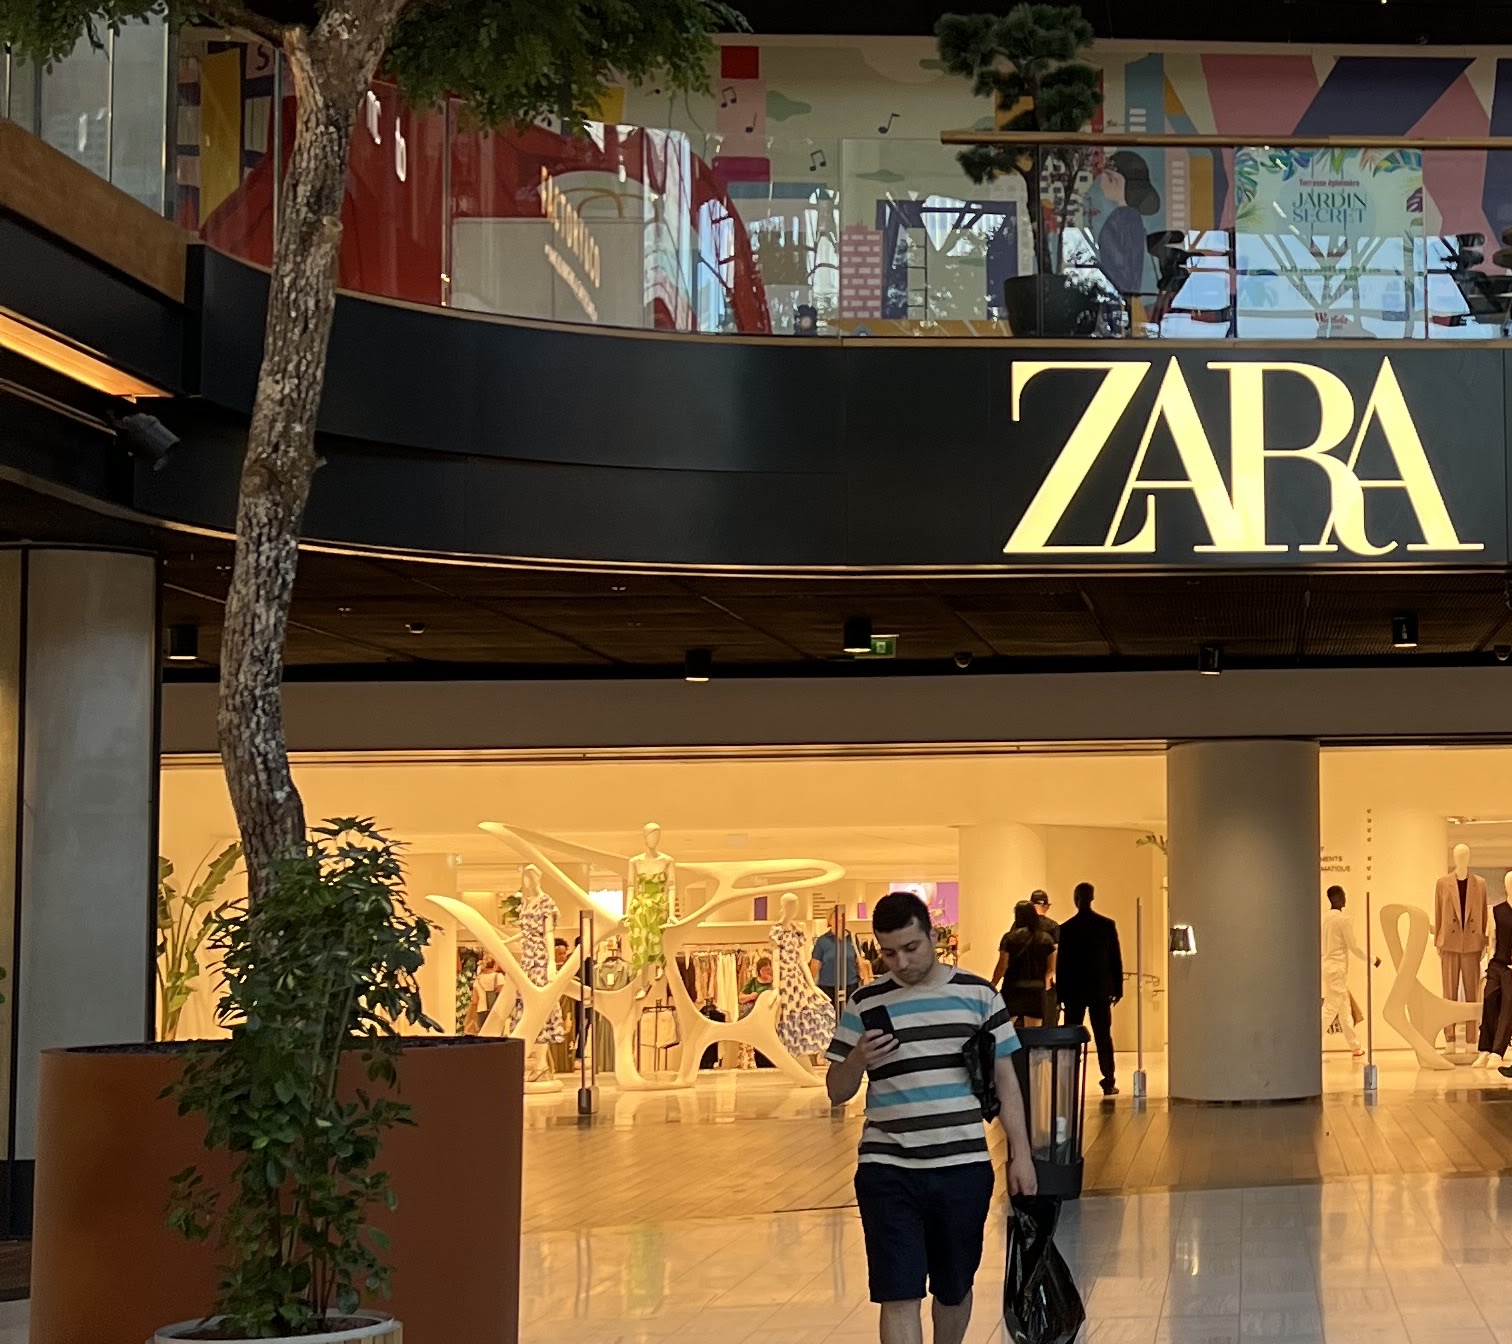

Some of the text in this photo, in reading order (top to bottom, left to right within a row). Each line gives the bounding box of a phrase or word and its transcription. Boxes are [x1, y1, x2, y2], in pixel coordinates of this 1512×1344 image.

[1292, 192, 1367, 208] JARDIN
[1292, 208, 1366, 224] SECRET
[1002, 355, 1485, 556] ZARA
